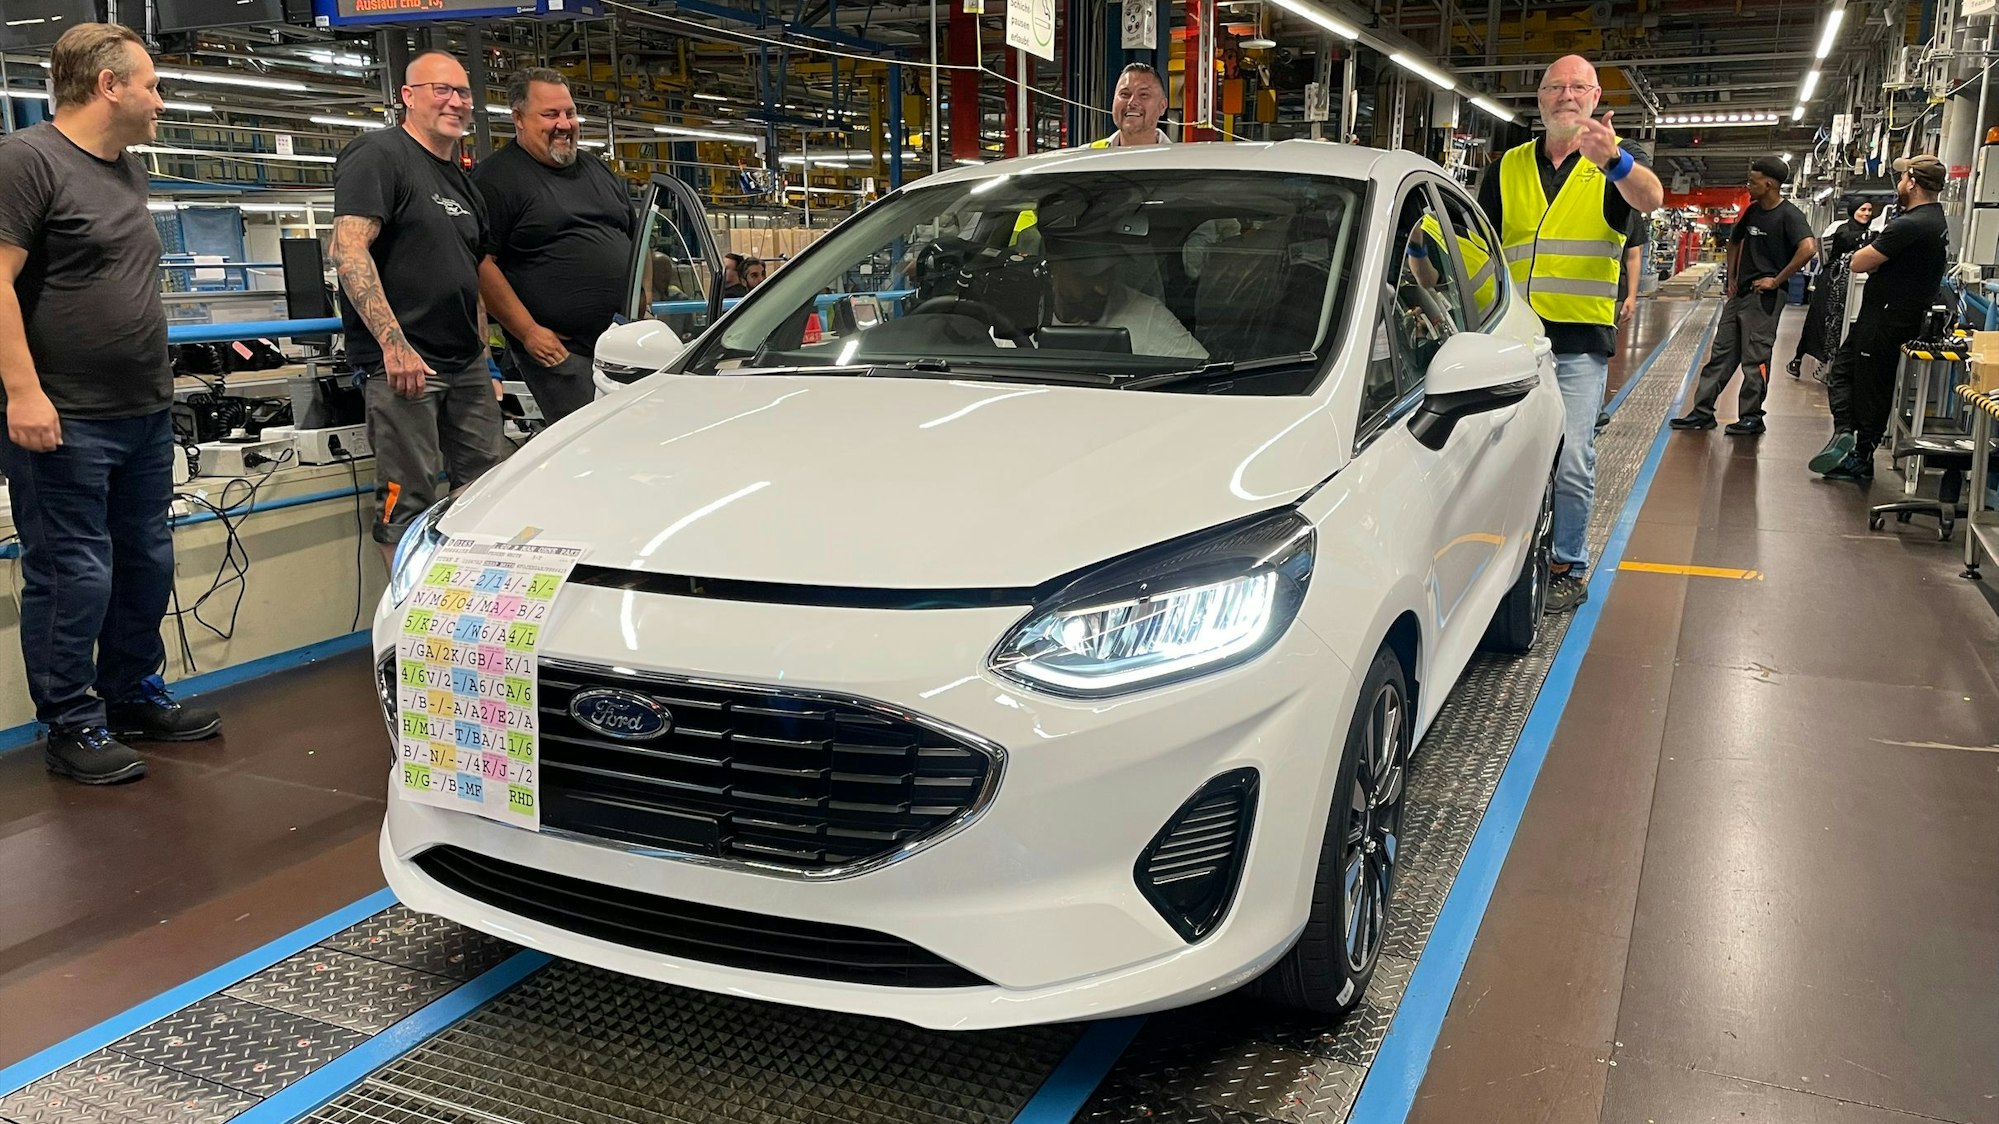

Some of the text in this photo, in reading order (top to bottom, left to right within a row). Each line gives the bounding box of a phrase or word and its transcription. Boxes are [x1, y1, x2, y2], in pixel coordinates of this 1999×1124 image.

[1011, 16, 1030, 30] pausen
[1011, 33, 1029, 46] erlaubt
[590, 700, 644, 731] Ford
[509, 789, 534, 807] RHD
